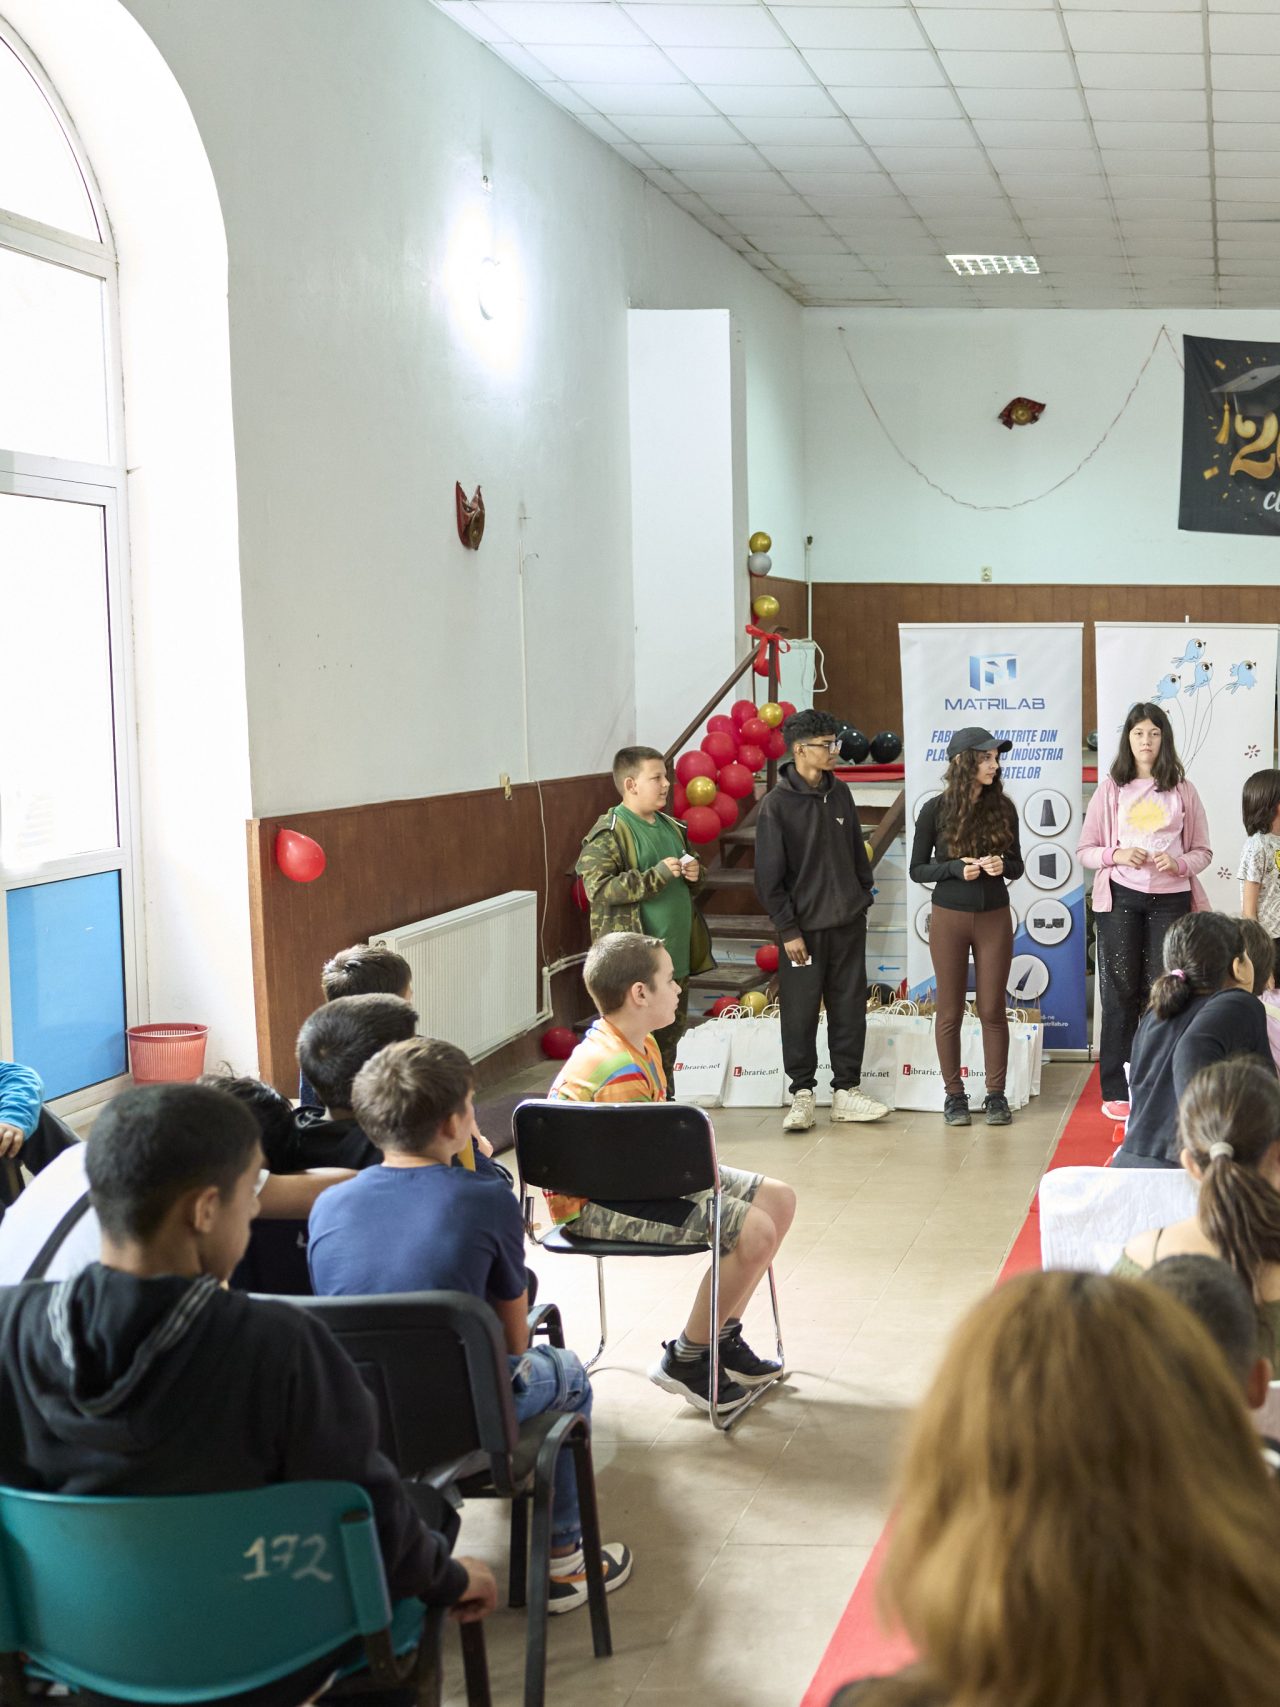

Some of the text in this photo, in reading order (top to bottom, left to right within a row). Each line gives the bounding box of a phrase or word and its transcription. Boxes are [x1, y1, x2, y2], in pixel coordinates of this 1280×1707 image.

[945, 698, 1045, 711] MATRILAB
[1039, 729, 1058, 743] DIN
[1010, 747, 1064, 761] INDUSTRIA
[673, 1062, 721, 1072] Librarie.net
[733, 1066, 779, 1077] Librarie.net
[859, 1070, 889, 1078] rarie.net
[242, 1533, 335, 1583] 172
